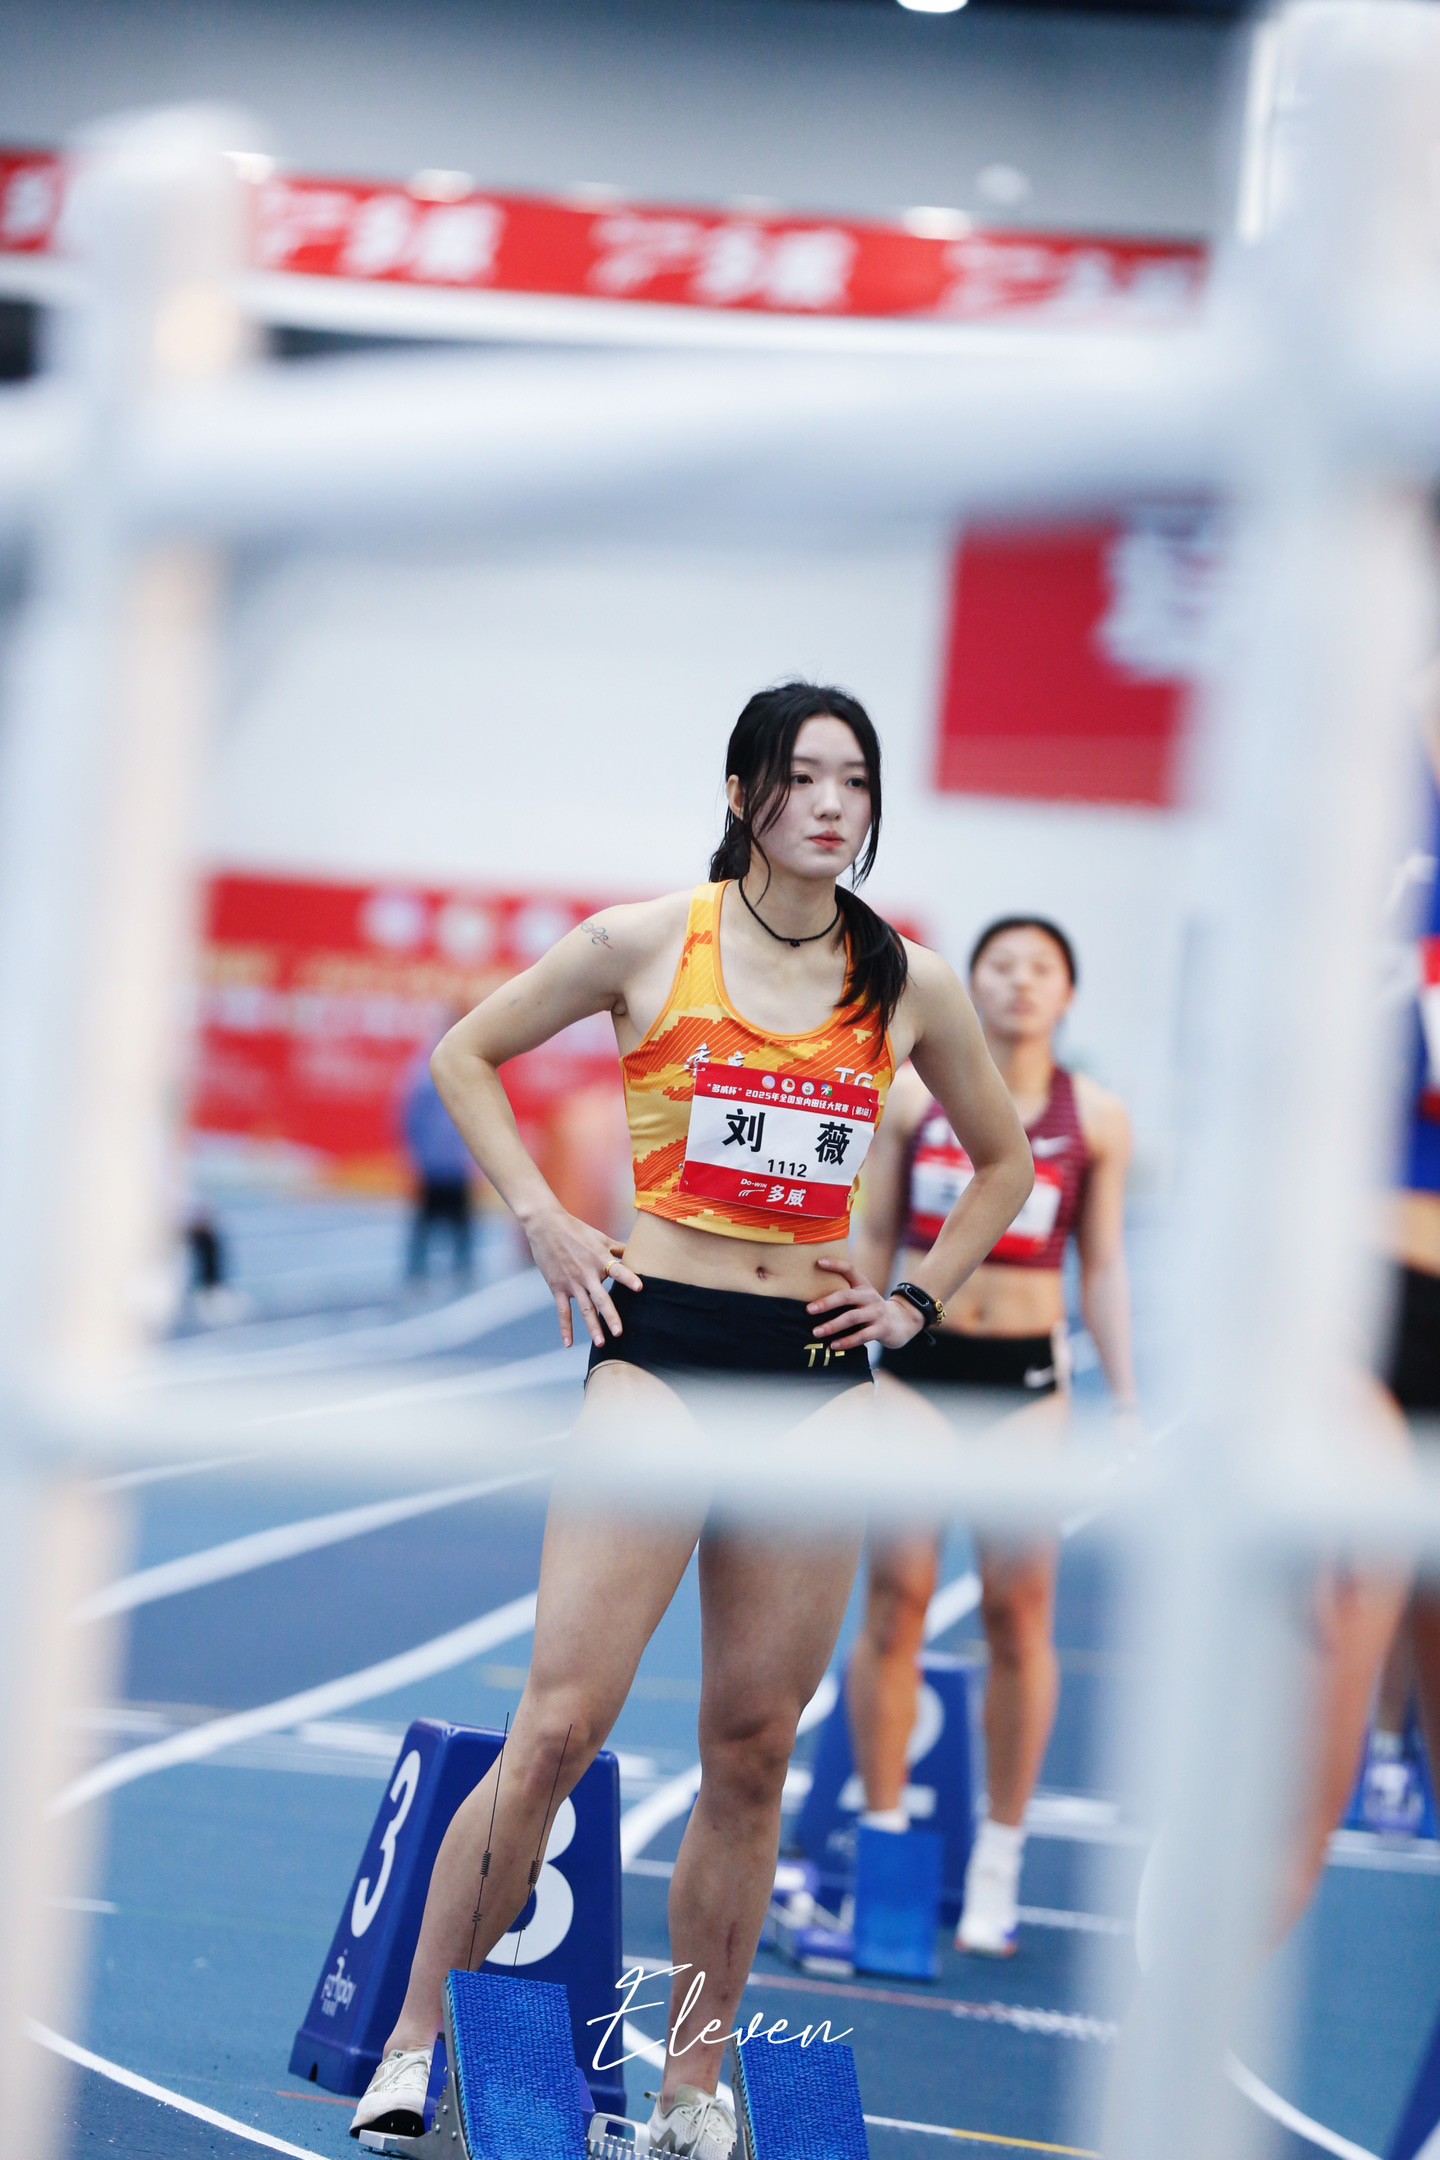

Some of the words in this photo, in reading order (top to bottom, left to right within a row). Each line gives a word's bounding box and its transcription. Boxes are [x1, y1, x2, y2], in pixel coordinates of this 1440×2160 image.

[767, 1159, 807, 1177] 1112
[766, 1185, 806, 1207] 多威
[351, 1750, 421, 1938] 3
